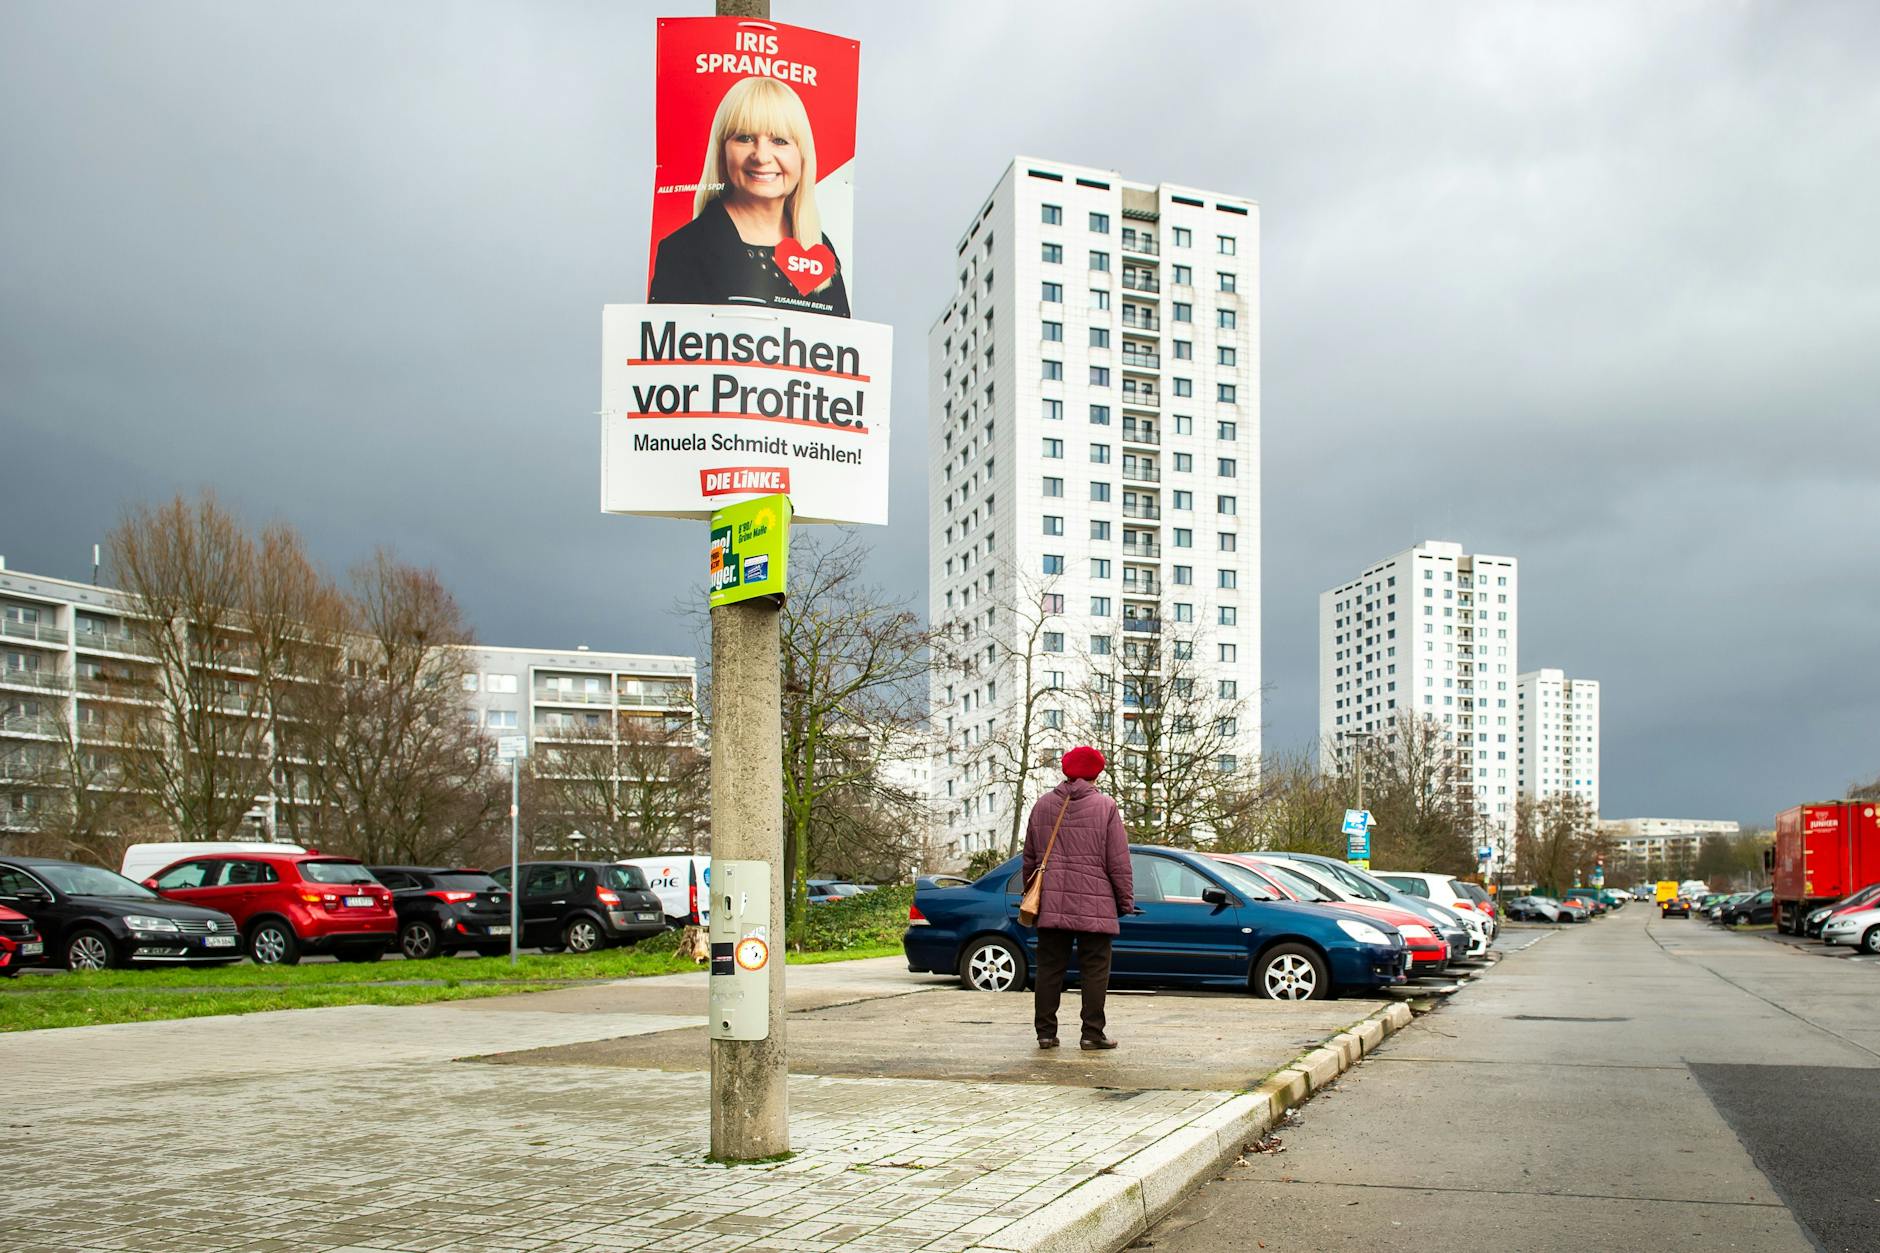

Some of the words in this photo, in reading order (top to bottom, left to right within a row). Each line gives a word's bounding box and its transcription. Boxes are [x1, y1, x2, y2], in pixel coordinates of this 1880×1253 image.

[735, 31, 779, 55] IRIS
[695, 54, 818, 87] SPRANGER
[657, 186, 674, 194] ALLE
[674, 183, 707, 193] STIMMEN
[708, 183, 725, 191] SPD!
[787, 255, 823, 276] SPD
[774, 295, 811, 309] ZUSAMMEN
[811, 301, 833, 311] BERLIN
[640, 321, 860, 377] Menschen
[632, 384, 699, 415] vor
[712, 373, 865, 429] Profite!
[634, 433, 707, 452] Manuela
[711, 433, 788, 456] Schmidt
[792, 442, 862, 465] wählen!
[706, 472, 731, 491] DIE
[733, 470, 786, 490] LINKE.
